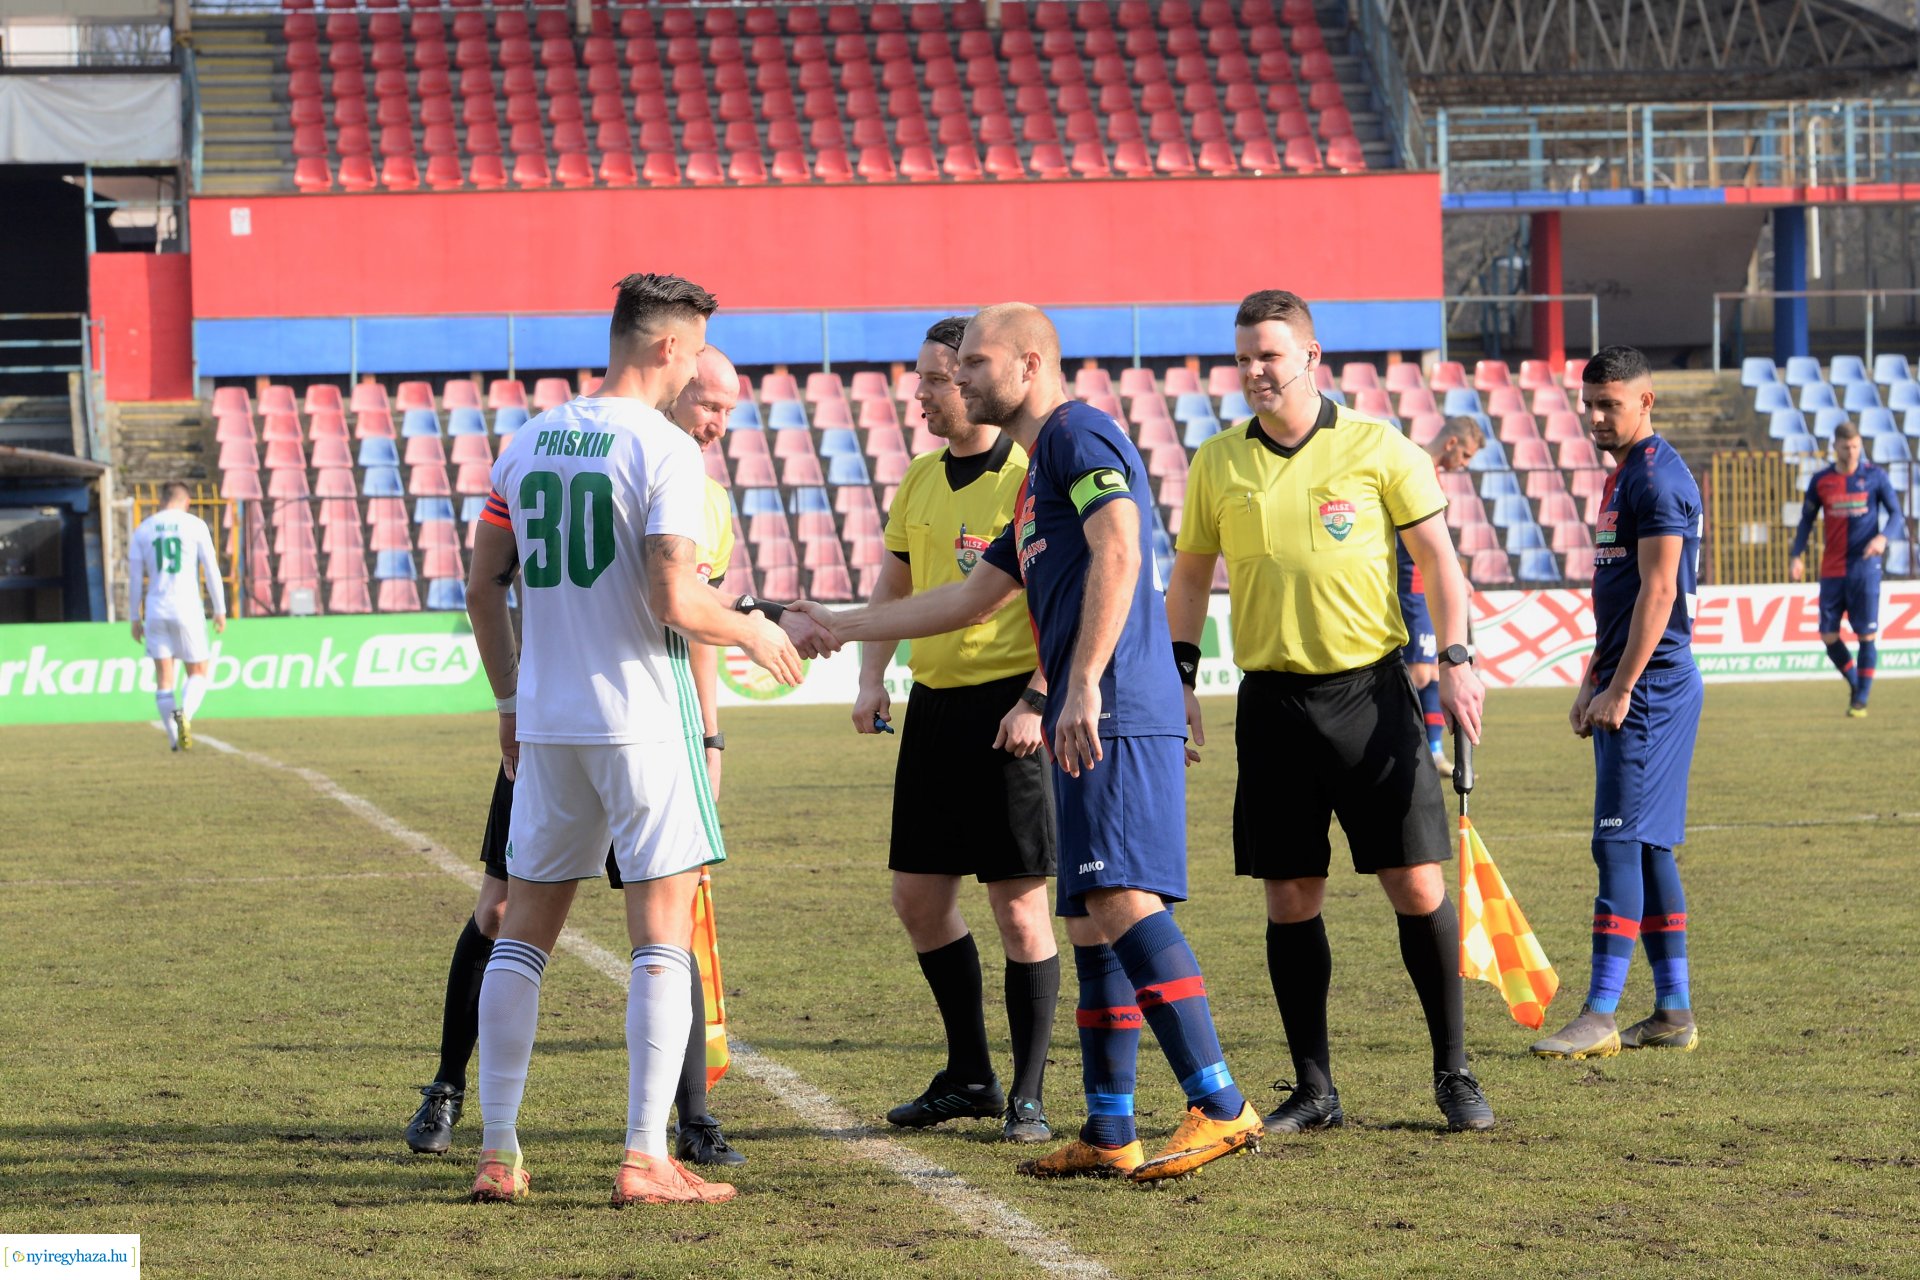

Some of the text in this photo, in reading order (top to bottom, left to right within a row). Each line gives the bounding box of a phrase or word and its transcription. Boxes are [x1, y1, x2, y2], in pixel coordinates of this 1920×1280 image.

[533, 430, 616, 458] PRISKIN
[1093, 469, 1121, 491] C
[1327, 503, 1350, 512] MLSZ
[519, 470, 616, 589] 30
[152, 536, 182, 575] 19
[1690, 593, 1920, 643] EVEZ
[369, 645, 469, 674] LIGA
[1754, 655, 1781, 670] ON
[1785, 654, 1820, 669] THE
[1599, 817, 1623, 828] JAKO
[1078, 860, 1105, 875] JAKO
